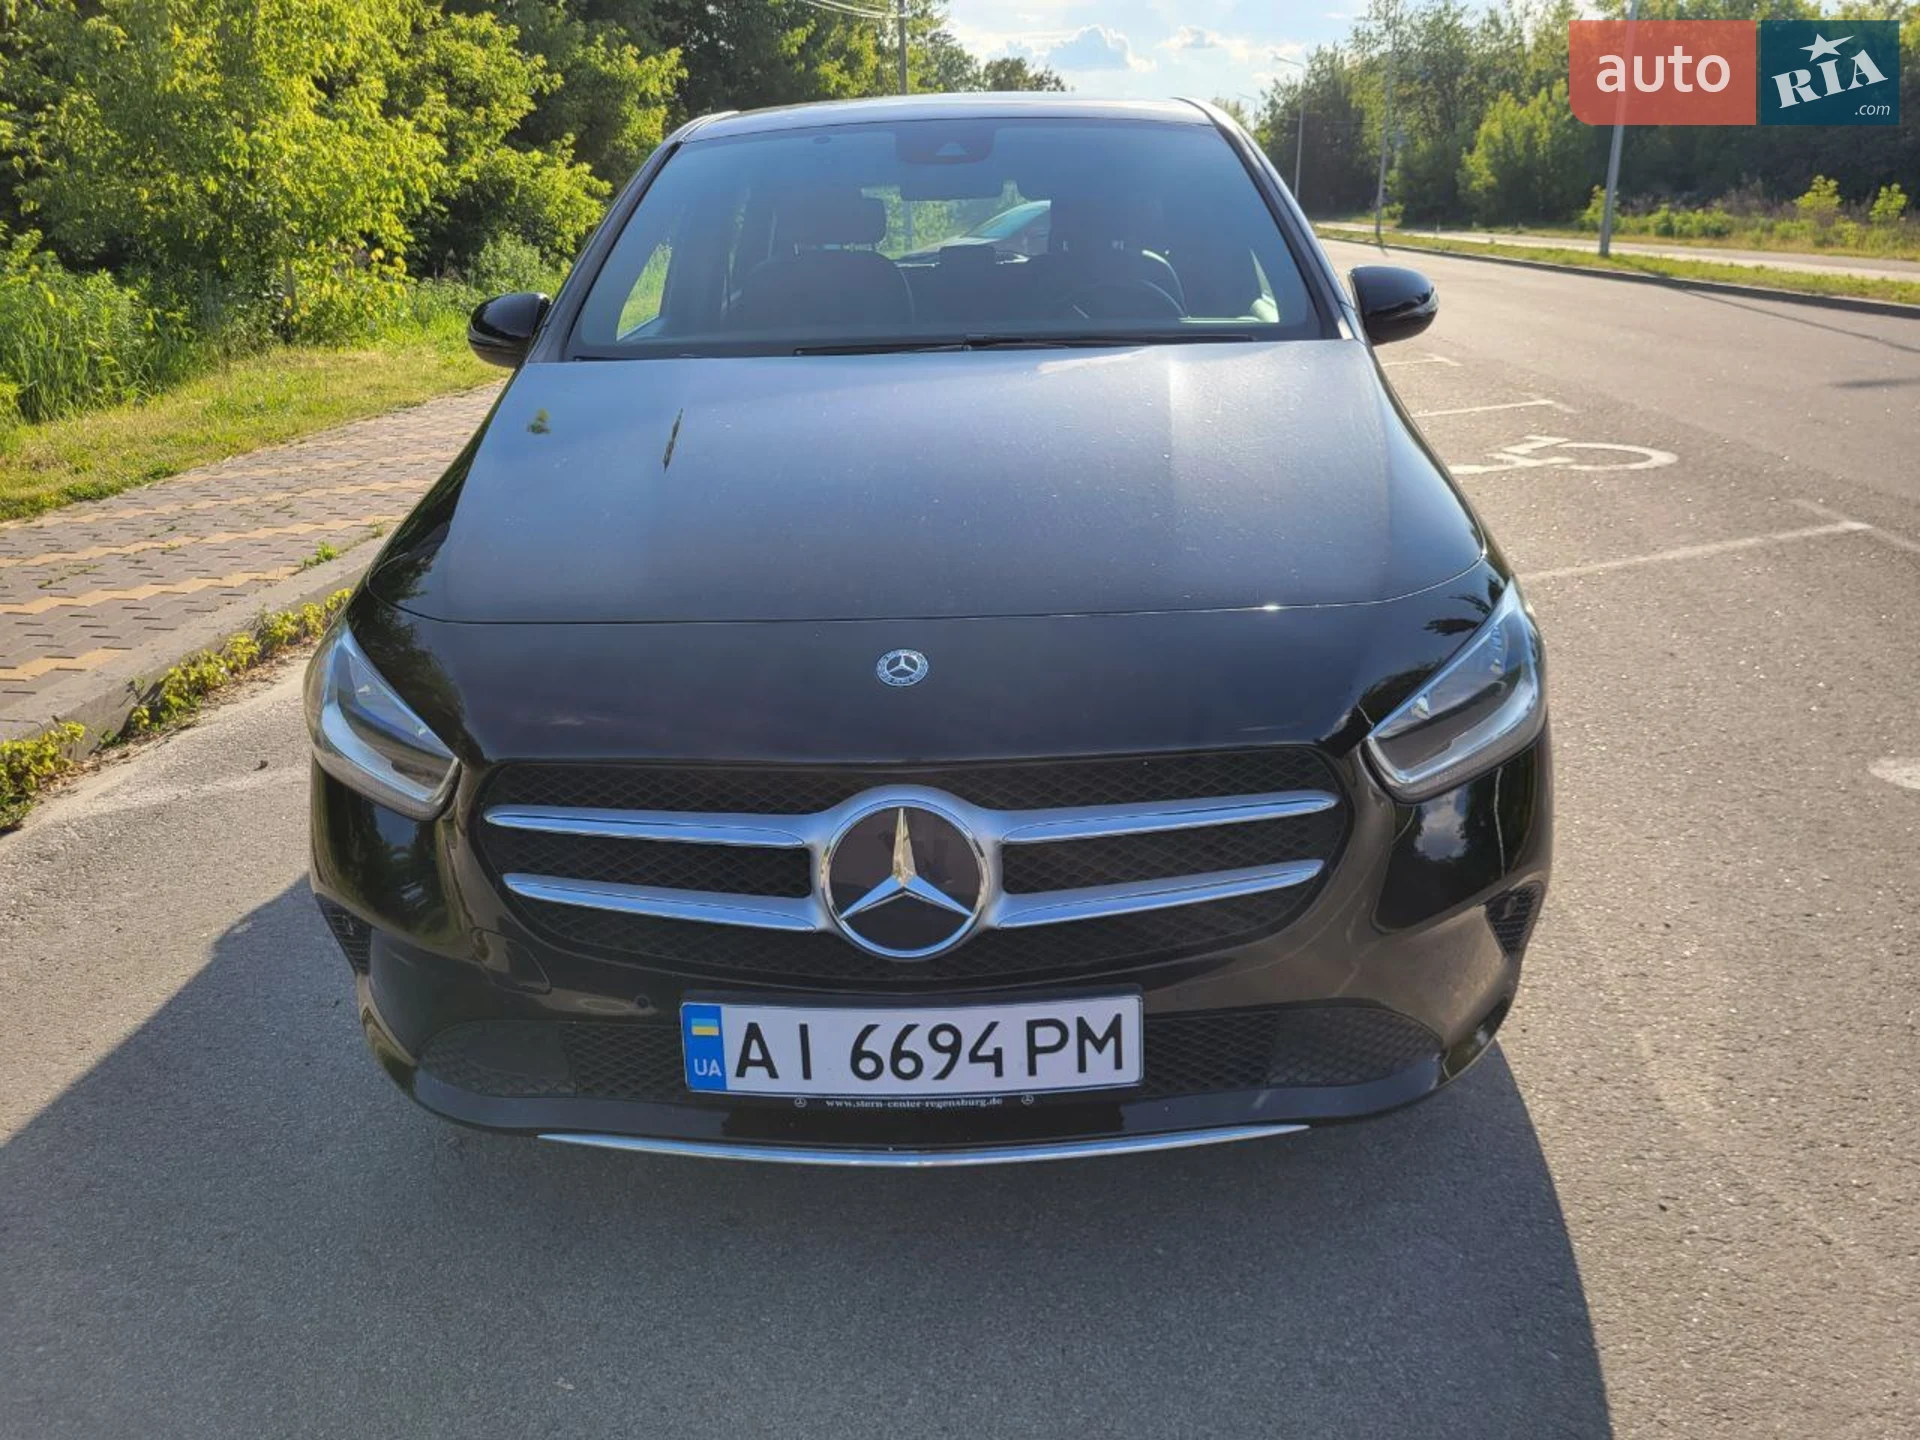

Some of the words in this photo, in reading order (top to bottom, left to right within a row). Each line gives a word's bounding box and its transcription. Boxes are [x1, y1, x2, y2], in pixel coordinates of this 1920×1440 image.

[693, 1058, 723, 1077] UA
[735, 1021, 812, 1081] AI
[849, 1020, 1005, 1081] 6694
[1025, 1012, 1124, 1077] PM
